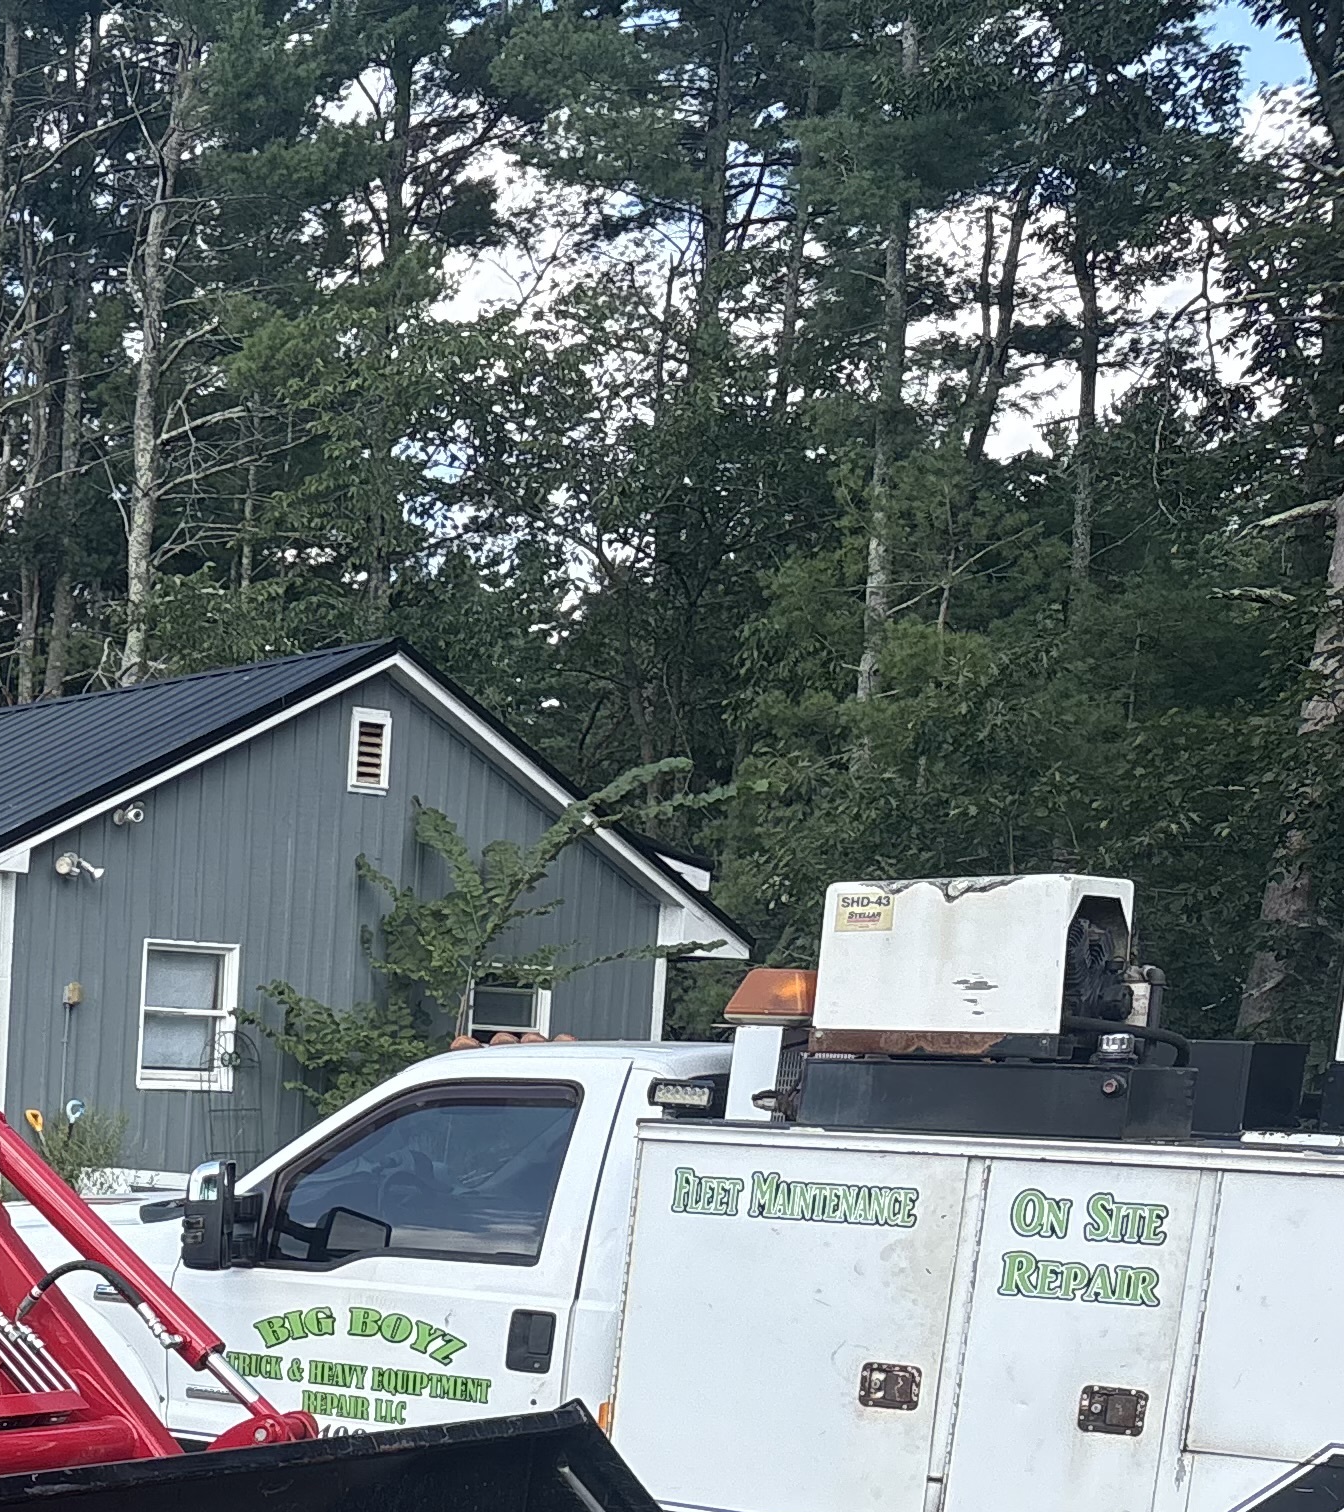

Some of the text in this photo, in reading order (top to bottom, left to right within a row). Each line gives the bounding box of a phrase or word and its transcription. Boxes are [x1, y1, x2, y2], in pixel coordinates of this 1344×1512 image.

[841, 895, 891, 908] SHD-43
[671, 1167, 919, 1228] FLEET MAINTENANCE
[1010, 1188, 1169, 1246] ON SITE
[997, 1250, 1161, 1307] REPAIR
[253, 1306, 467, 1366] BIG BOYZ
[226, 1351, 491, 1404] TRUCK & HEAVY EQUIPTMENT
[302, 1390, 407, 1425] REPAIR LLC
